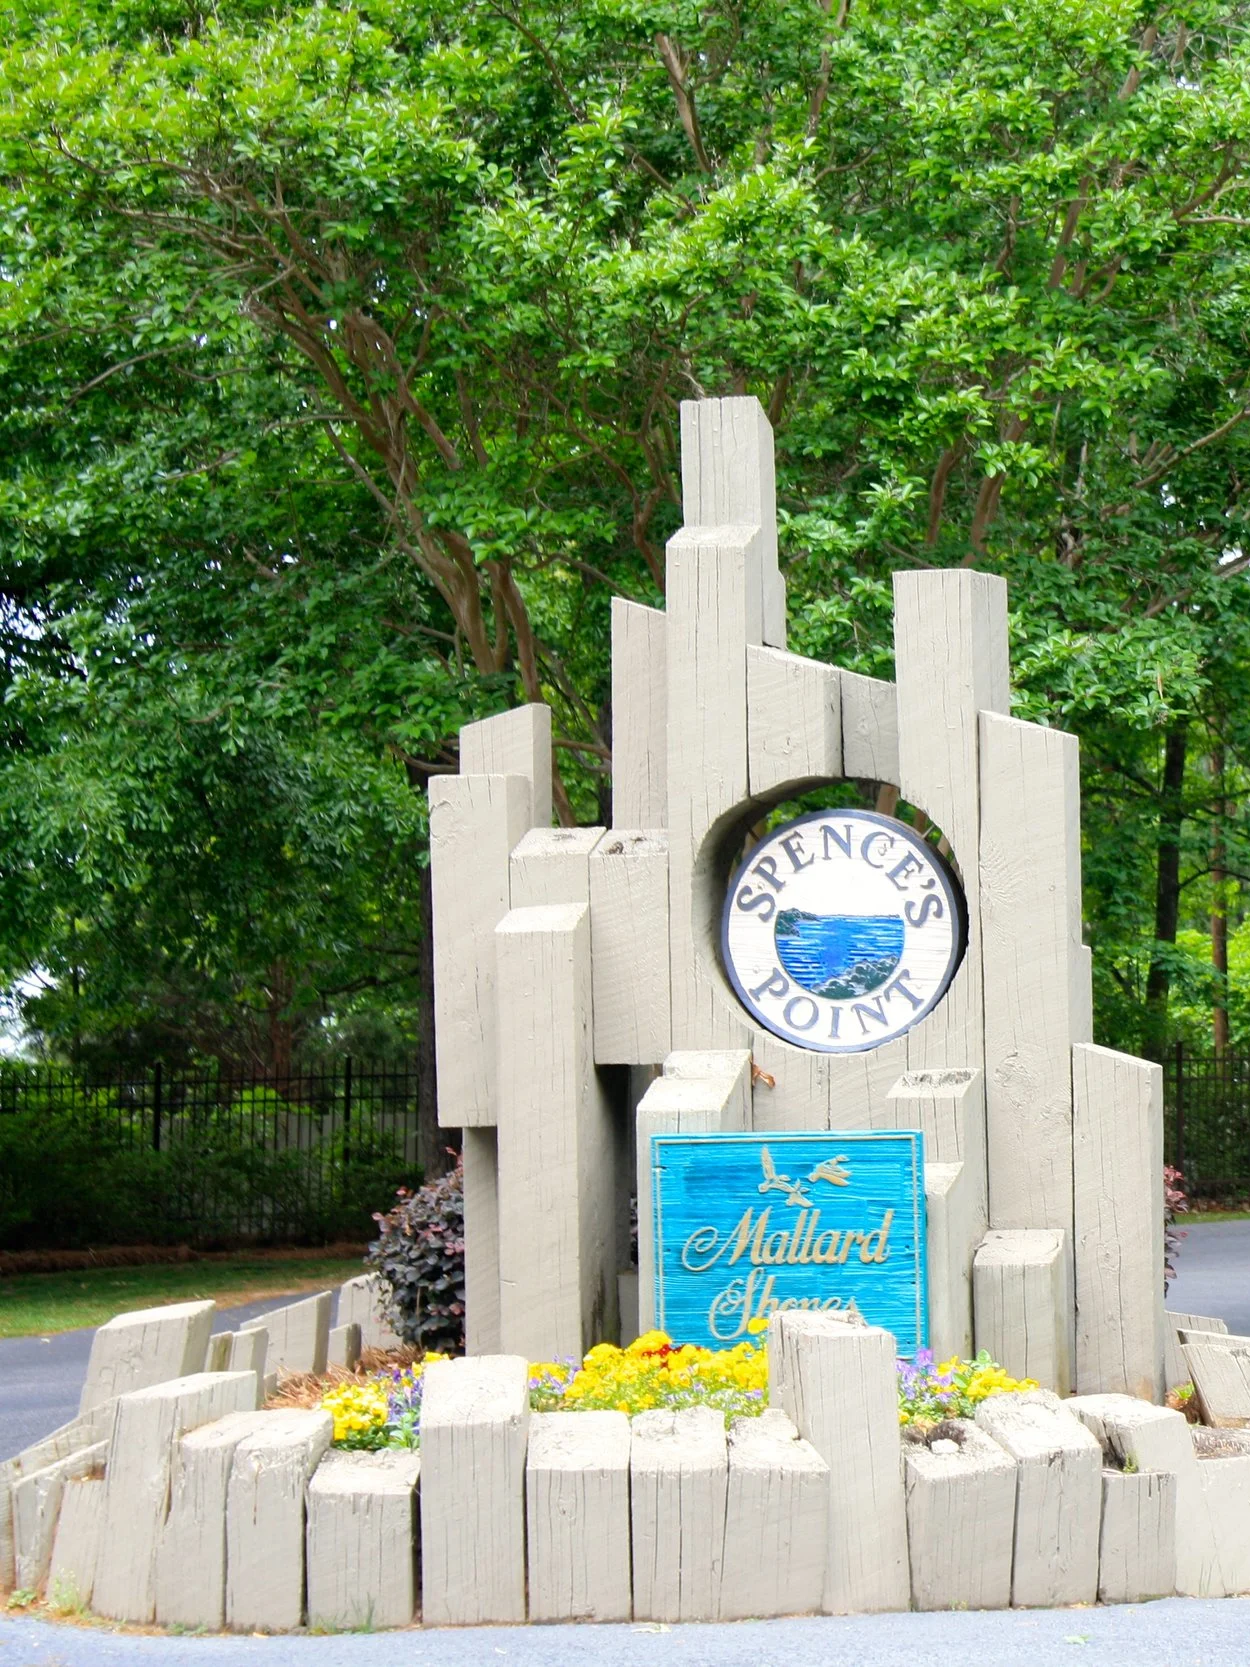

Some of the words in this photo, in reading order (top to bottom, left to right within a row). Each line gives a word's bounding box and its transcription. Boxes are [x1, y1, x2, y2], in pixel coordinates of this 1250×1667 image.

[736, 824, 943, 928] SPENCE'S
[748, 967, 925, 1039] POINT
[681, 1205, 895, 1272] Mallard
